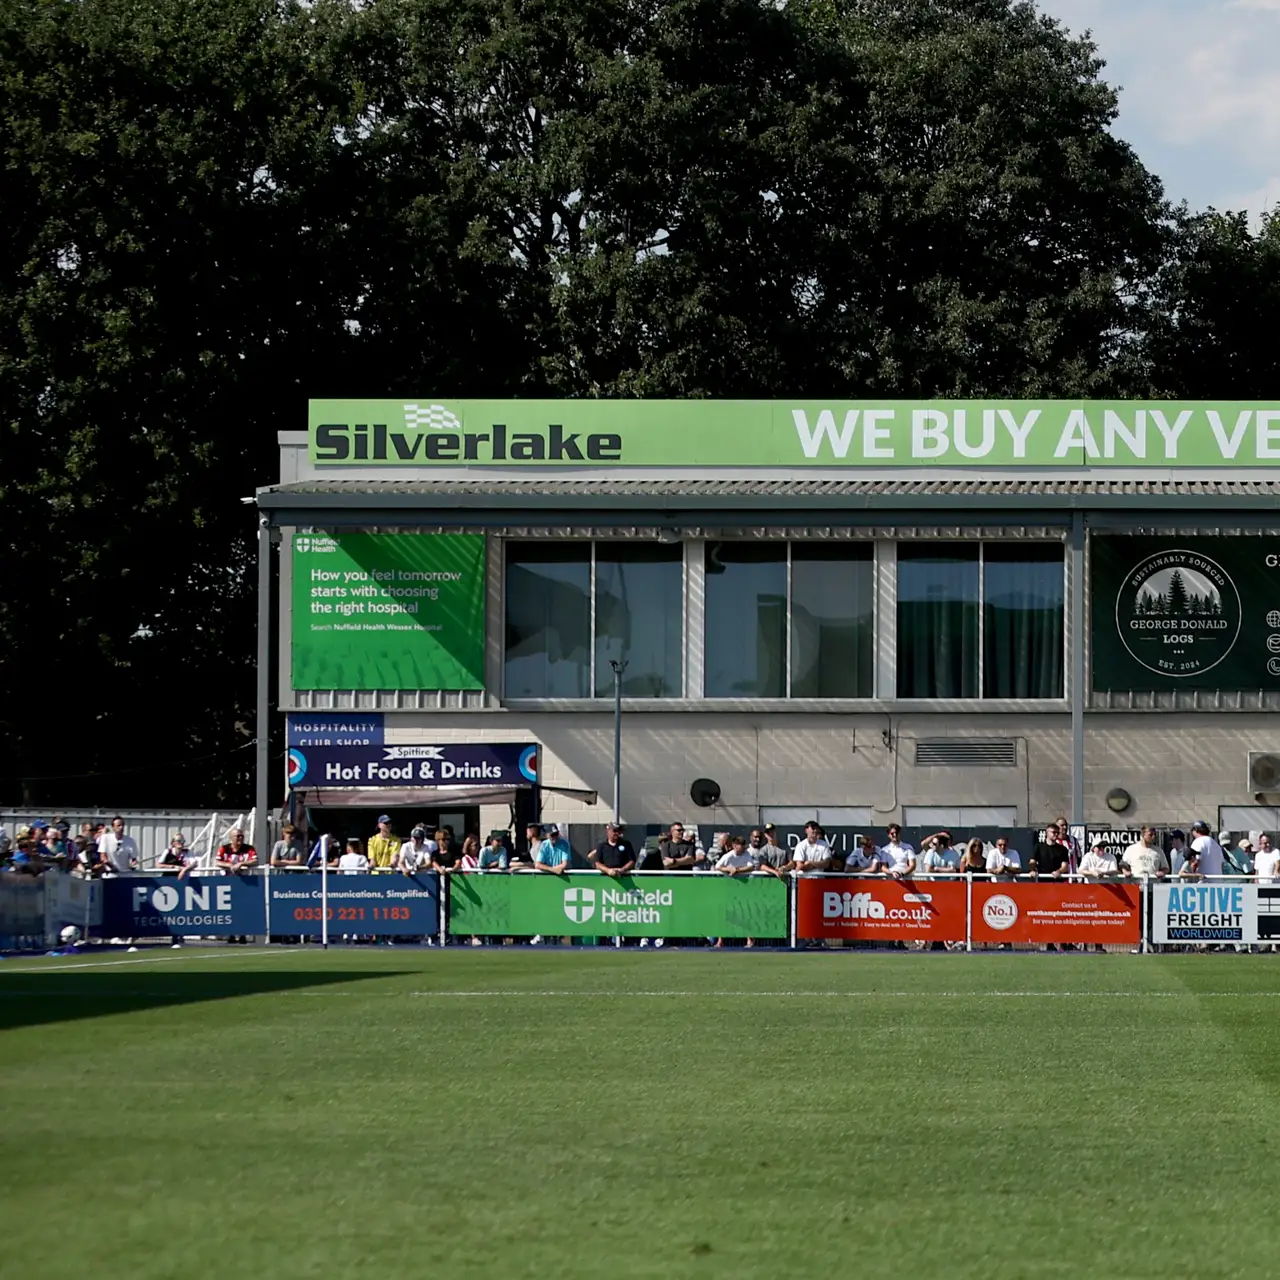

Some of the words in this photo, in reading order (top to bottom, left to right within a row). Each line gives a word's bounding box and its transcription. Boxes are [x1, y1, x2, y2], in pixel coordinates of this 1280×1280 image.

[792, 410, 895, 458] WE
[911, 410, 1042, 458] BUY
[1053, 410, 1193, 458] ANY
[315, 424, 622, 461] Silverlake
[311, 545, 337, 553] Health
[311, 569, 341, 581] How
[343, 571, 369, 585] you
[371, 569, 395, 581] feel
[399, 570, 462, 581] tomorrow
[1132, 555, 1186, 587] SUSTAINABLY
[1188, 557, 1225, 586] SOURCED
[311, 586, 347, 597] starts
[350, 585, 378, 597] with
[381, 586, 439, 600] choosing
[311, 601, 332, 613] the
[335, 601, 364, 616] right
[367, 601, 419, 616] hospital
[1130, 619, 1178, 629] GEORGE
[1180, 619, 1228, 629] DONALD
[1163, 634, 1194, 644] LOGS
[294, 724, 376, 732] HOSPITALITY
[397, 746, 430, 758] Spitfire
[326, 762, 361, 780] Hot
[367, 762, 412, 780] Food
[418, 761, 435, 780] &
[441, 761, 502, 779] Drinks
[787, 833, 864, 850] DVID
[273, 890, 310, 899] Business
[386, 889, 429, 901] Simplified
[1167, 888, 1242, 912] ACTIVE
[823, 892, 931, 919] Biffa.co.uk
[987, 905, 1013, 916] No.1
[135, 915, 232, 926] TECHNOLOGIES
[337, 907, 364, 920] 221
[373, 907, 411, 920] 1183
[602, 906, 660, 923] Health
[1167, 914, 1242, 927] FREIGHT
[1169, 928, 1241, 940] WORLDWIDE
